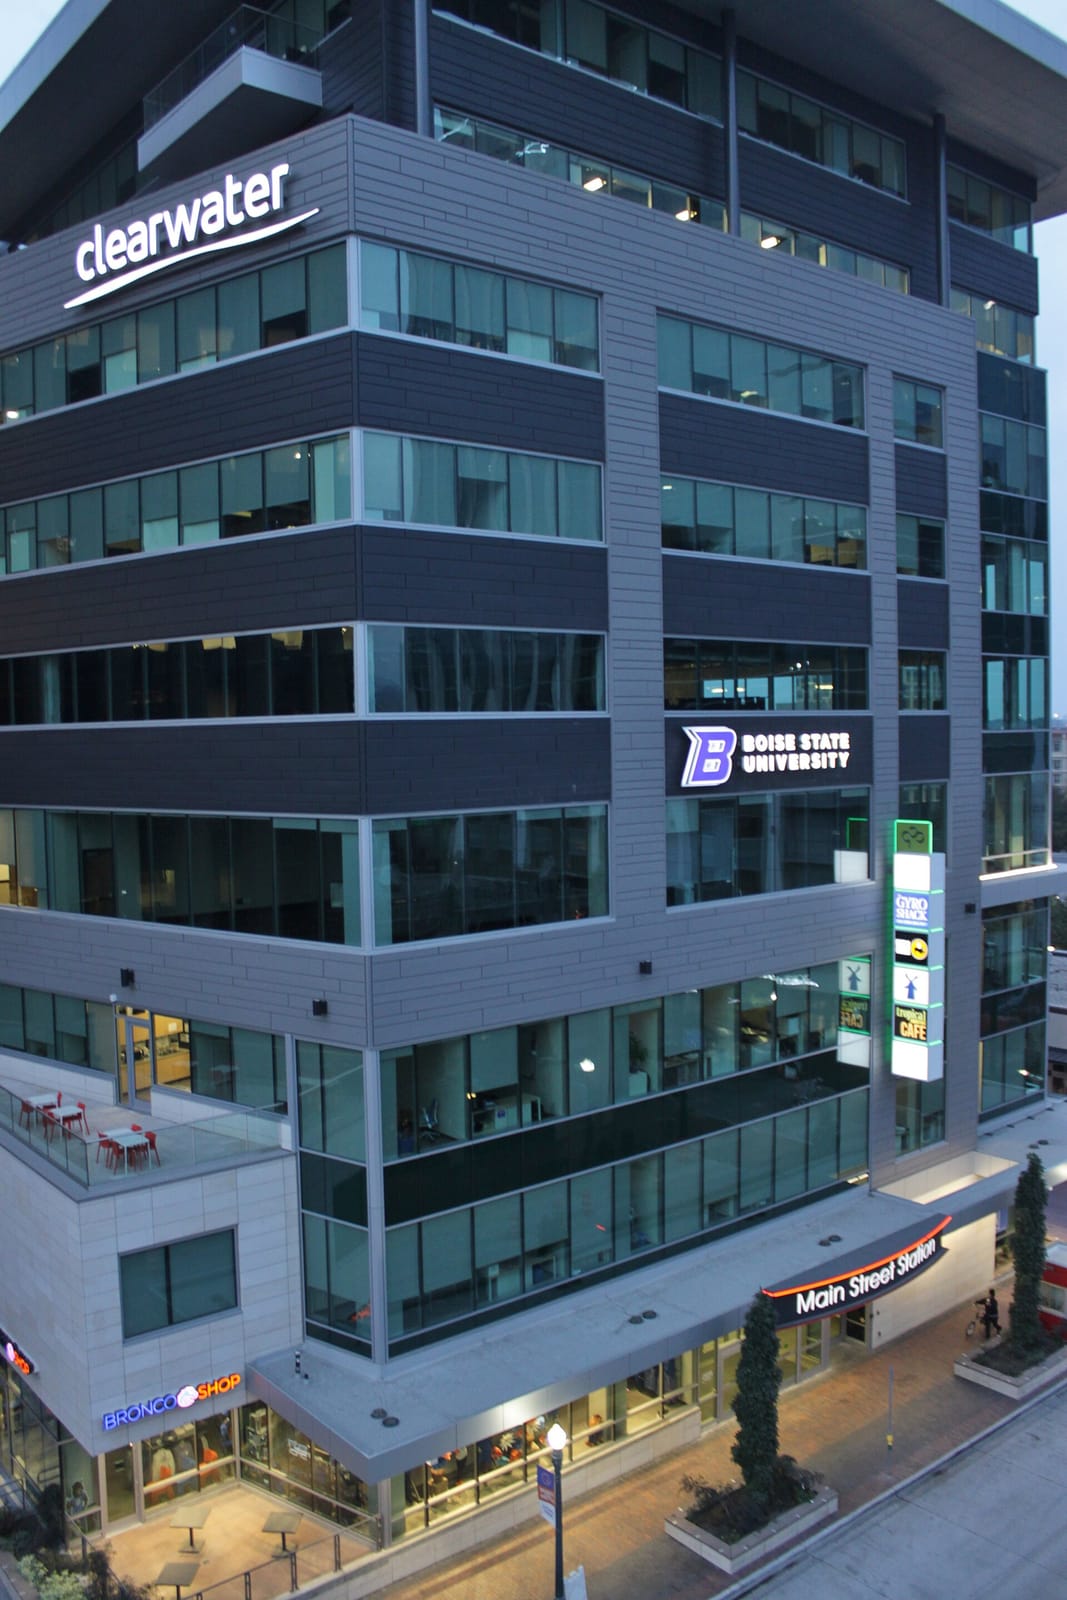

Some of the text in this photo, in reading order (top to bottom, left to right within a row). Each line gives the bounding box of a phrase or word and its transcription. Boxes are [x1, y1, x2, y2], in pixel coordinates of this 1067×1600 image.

[76, 163, 289, 281] clearwater
[741, 733, 850, 752] BOISE STATE
[741, 752, 850, 773] UNIVERSITY
[895, 895, 928, 911] GYRO
[895, 908, 928, 921] SHACK
[900, 1020, 927, 1040] CAFE
[796, 1238, 936, 1315] Main Street Station
[103, 1373, 241, 1430] BRONCO SHOP
